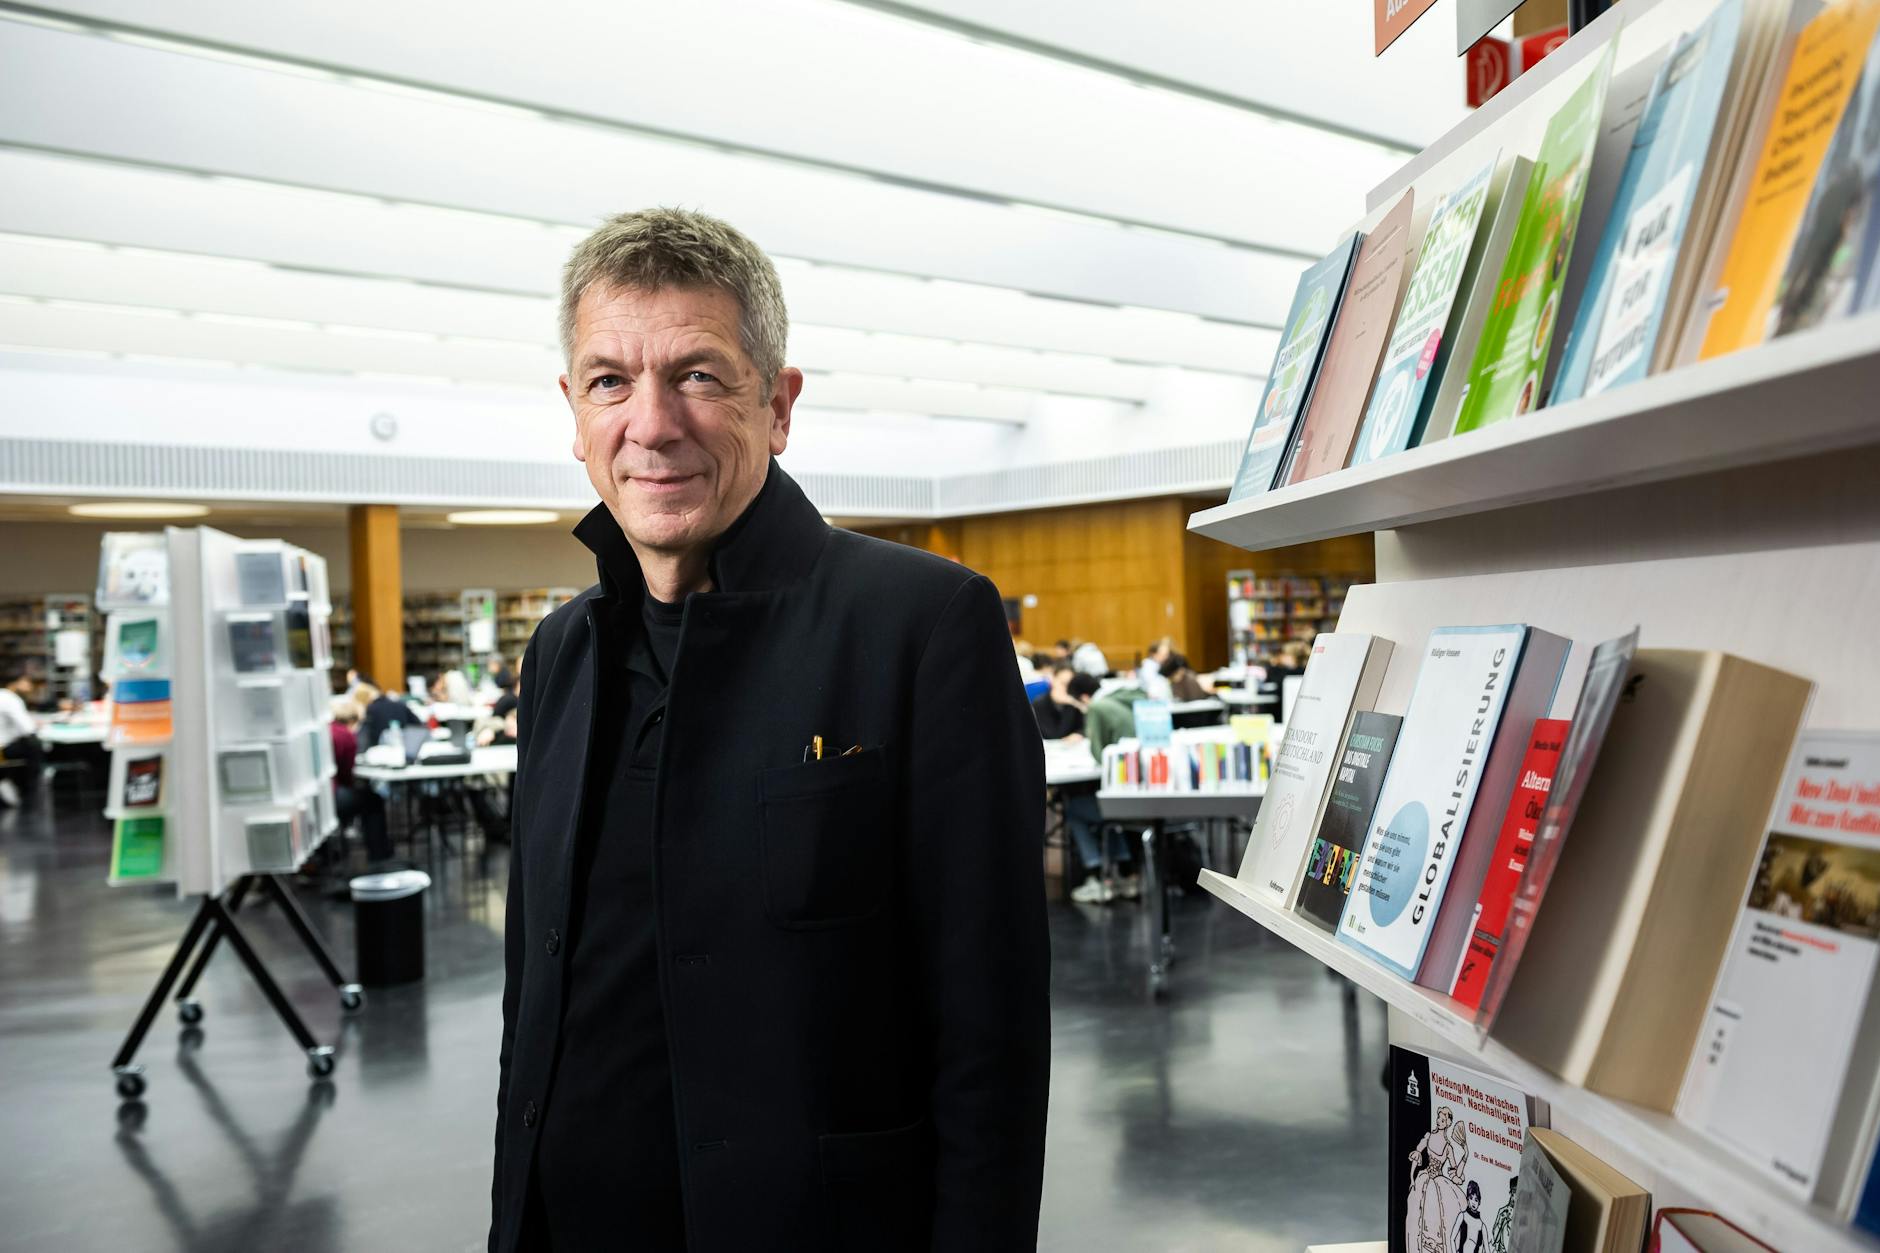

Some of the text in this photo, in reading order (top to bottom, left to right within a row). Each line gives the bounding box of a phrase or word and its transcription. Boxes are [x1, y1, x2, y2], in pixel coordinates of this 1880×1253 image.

[1400, 238, 1468, 325] ESSEN
[1285, 727, 1319, 746] STANDORT
[1280, 741, 1324, 765] DEUTSCHLAND
[1411, 648, 1506, 925] GLOBALISIERUNG
[1521, 769, 1552, 792] Altern
[1431, 1071, 1520, 1114] Kleidung/Mode zwischen
[1468, 1099, 1522, 1128] Nachhaltigkeit
[1468, 1122, 1524, 1155] Globalisierung
[1507, 1127, 1522, 1139] und
